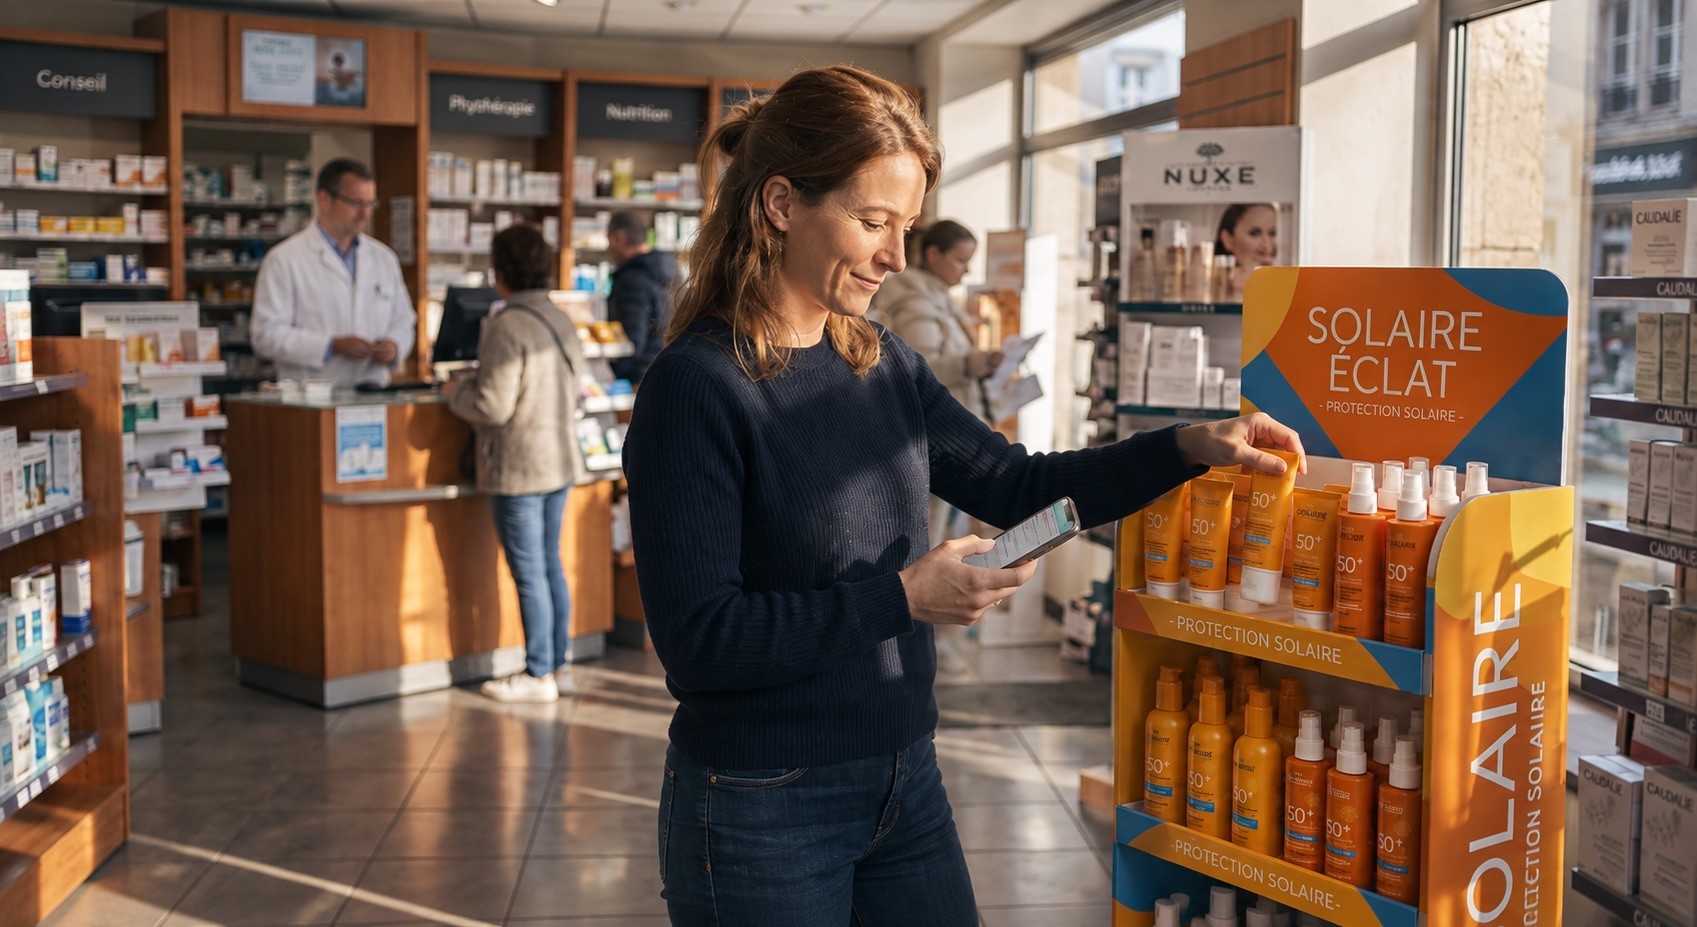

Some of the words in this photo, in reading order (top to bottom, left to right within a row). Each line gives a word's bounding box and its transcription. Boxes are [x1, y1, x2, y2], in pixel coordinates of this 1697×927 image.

[37, 69, 107, 92] Conseil
[606, 103, 672, 122] Nutrition
[1164, 166, 1255, 186] NUXE
[1307, 306, 1483, 352] SOLAIRE
[1329, 345, 1457, 398] ÉCLAT
[1326, 400, 1400, 418] PROTECTION
[1404, 407, 1456, 422] SOLAIRE
[1251, 491, 1277, 509] 50+
[1192, 518, 1216, 535] 50+
[1295, 534, 1322, 551] 50+
[1337, 555, 1363, 574] 50+
[1387, 563, 1415, 581] 50+
[1177, 616, 1270, 649] PROTECTION
[1274, 636, 1342, 664] SOLAIRE
[1466, 583, 1521, 927] OLAIRE
[1287, 804, 1314, 824] 50+
